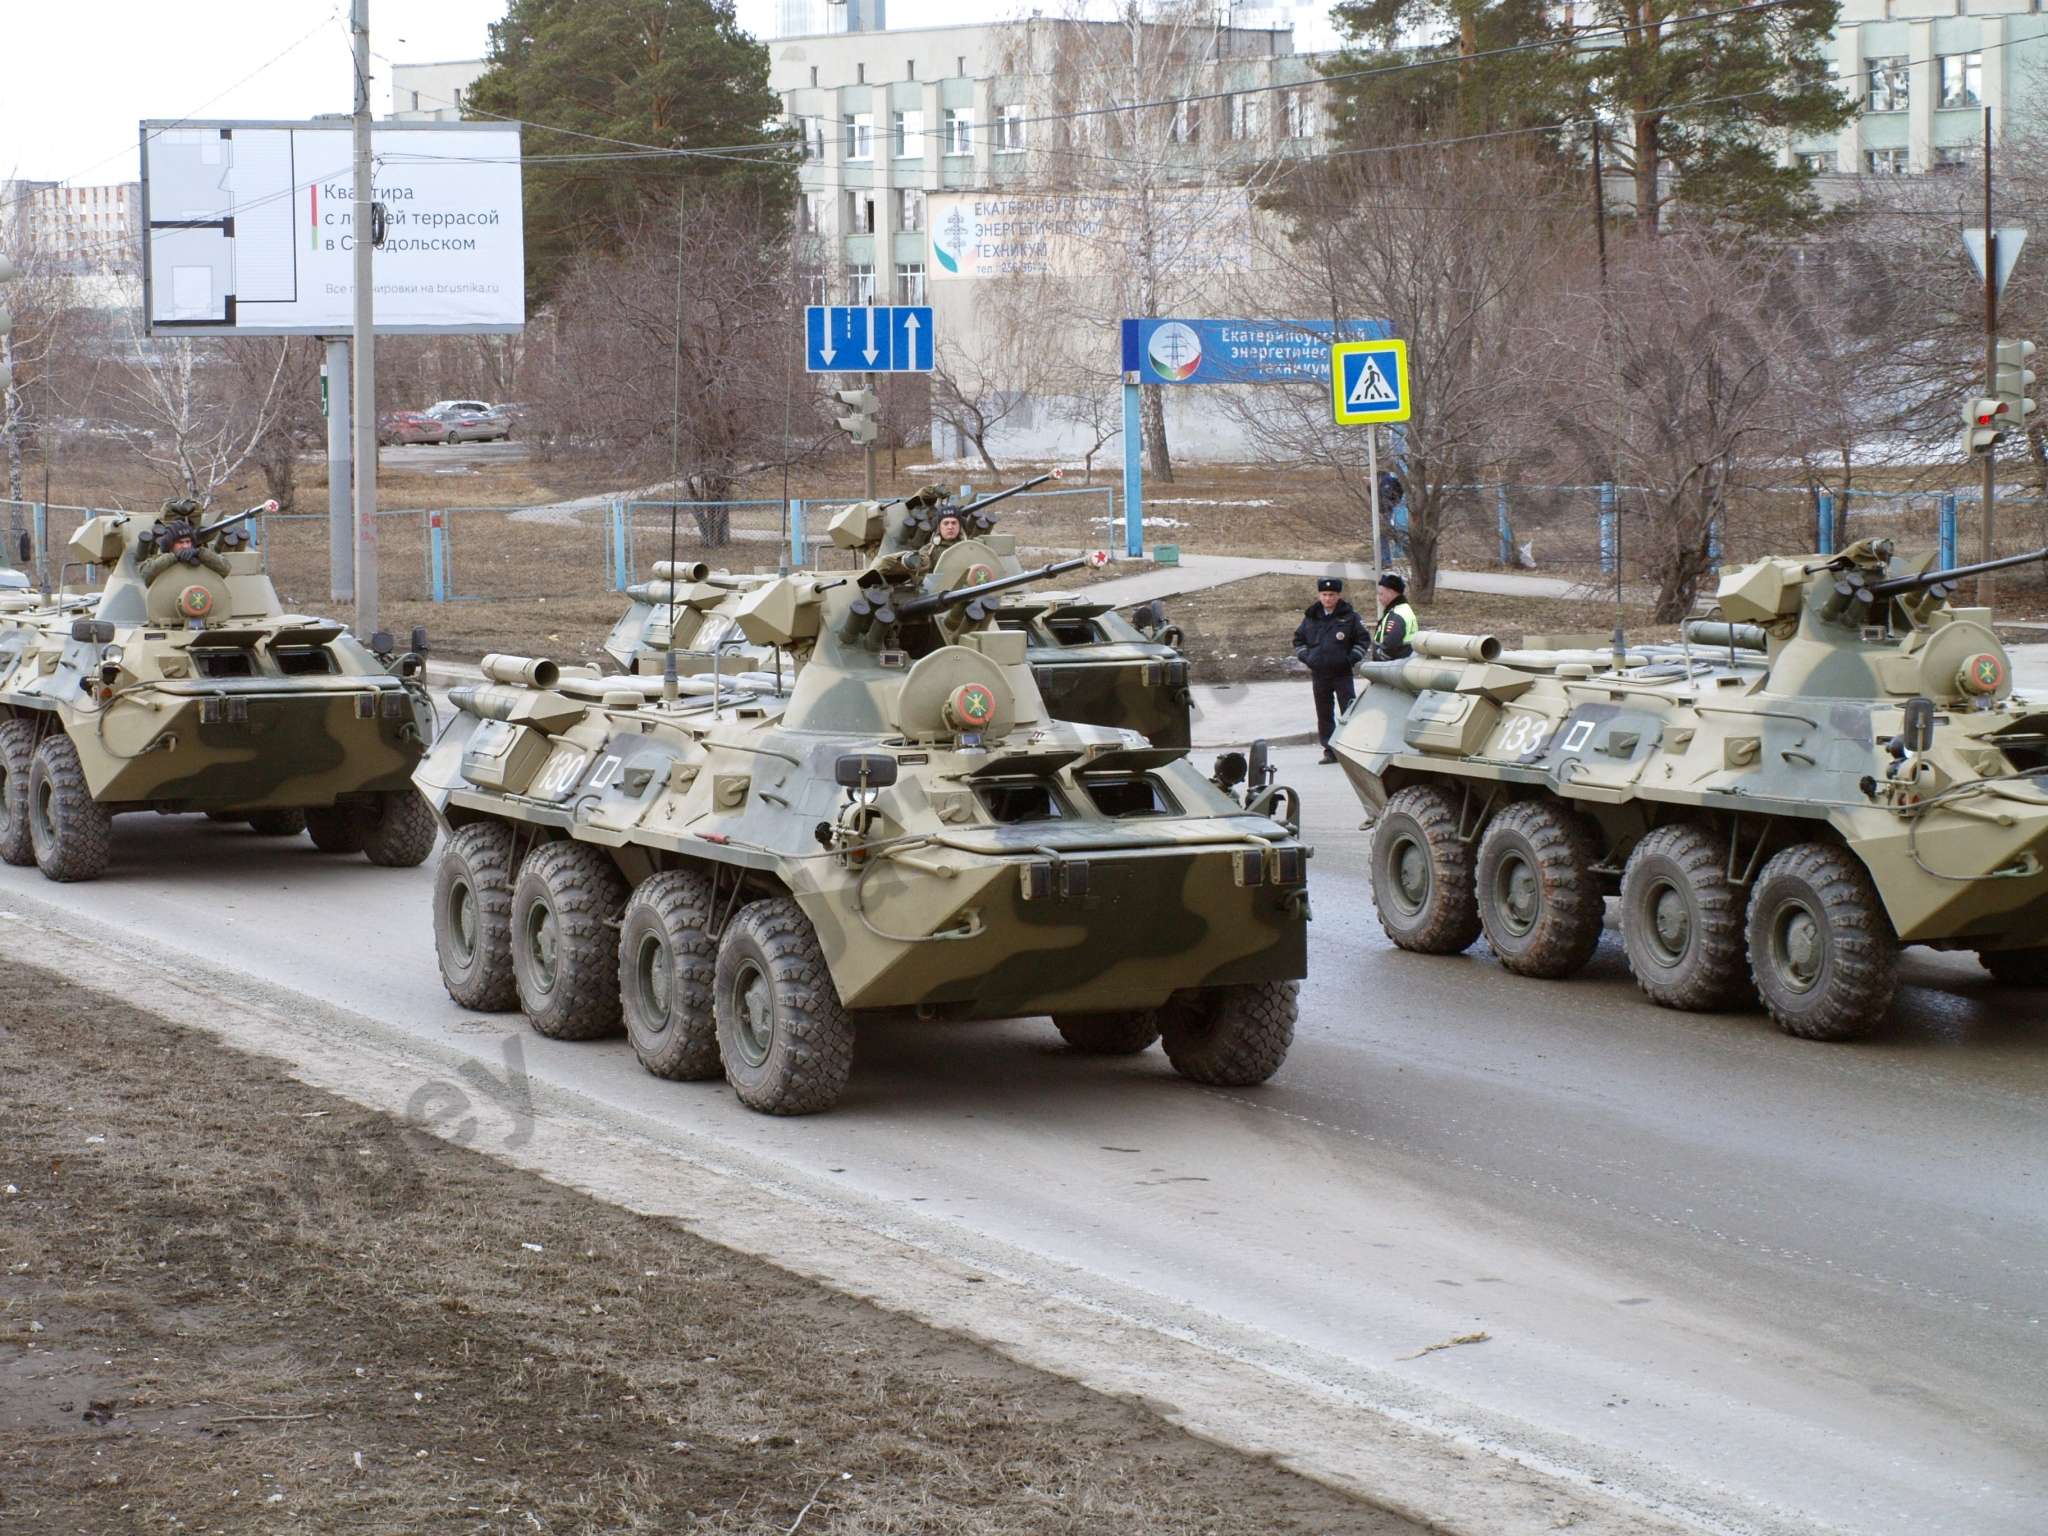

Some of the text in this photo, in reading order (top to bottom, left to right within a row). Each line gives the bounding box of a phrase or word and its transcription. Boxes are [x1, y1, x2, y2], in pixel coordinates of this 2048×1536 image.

[325, 184, 414, 202] Кватира
[325, 213, 335, 225] с
[412, 210, 499, 229] террасой
[326, 235, 475, 253] в Содольском
[975, 242, 1047, 258] ТЕХНИКУМ
[326, 283, 346, 294] Все
[420, 284, 433, 293] на
[437, 283, 499, 294] brusnika.ru
[1497, 714, 1548, 755] 133
[537, 750, 587, 793] 130
